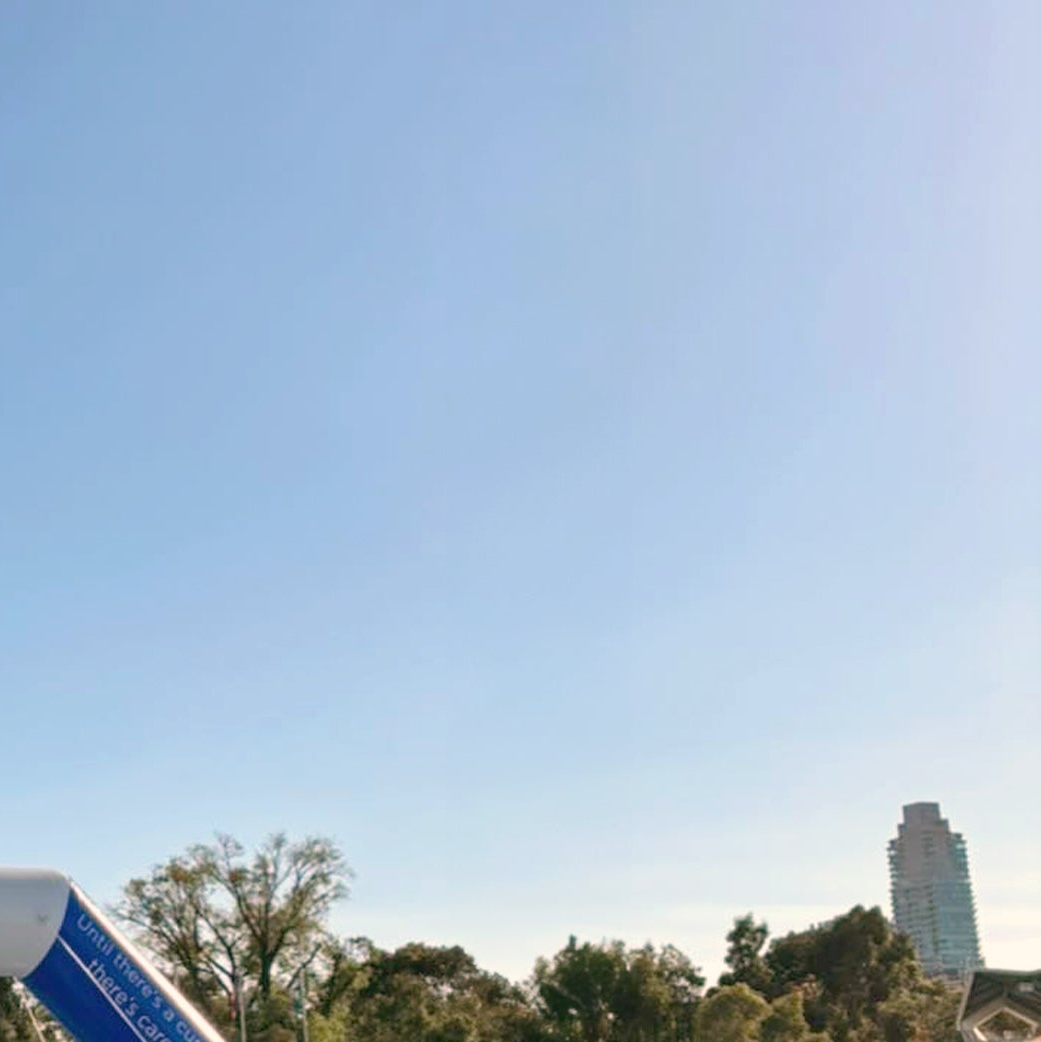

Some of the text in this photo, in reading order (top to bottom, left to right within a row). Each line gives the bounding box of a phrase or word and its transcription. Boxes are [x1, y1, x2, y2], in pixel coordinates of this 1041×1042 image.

[77, 913, 115, 956] Until
[113, 953, 164, 1009] there's
[162, 1009, 175, 1023] a
[88, 958, 140, 1017] there's
